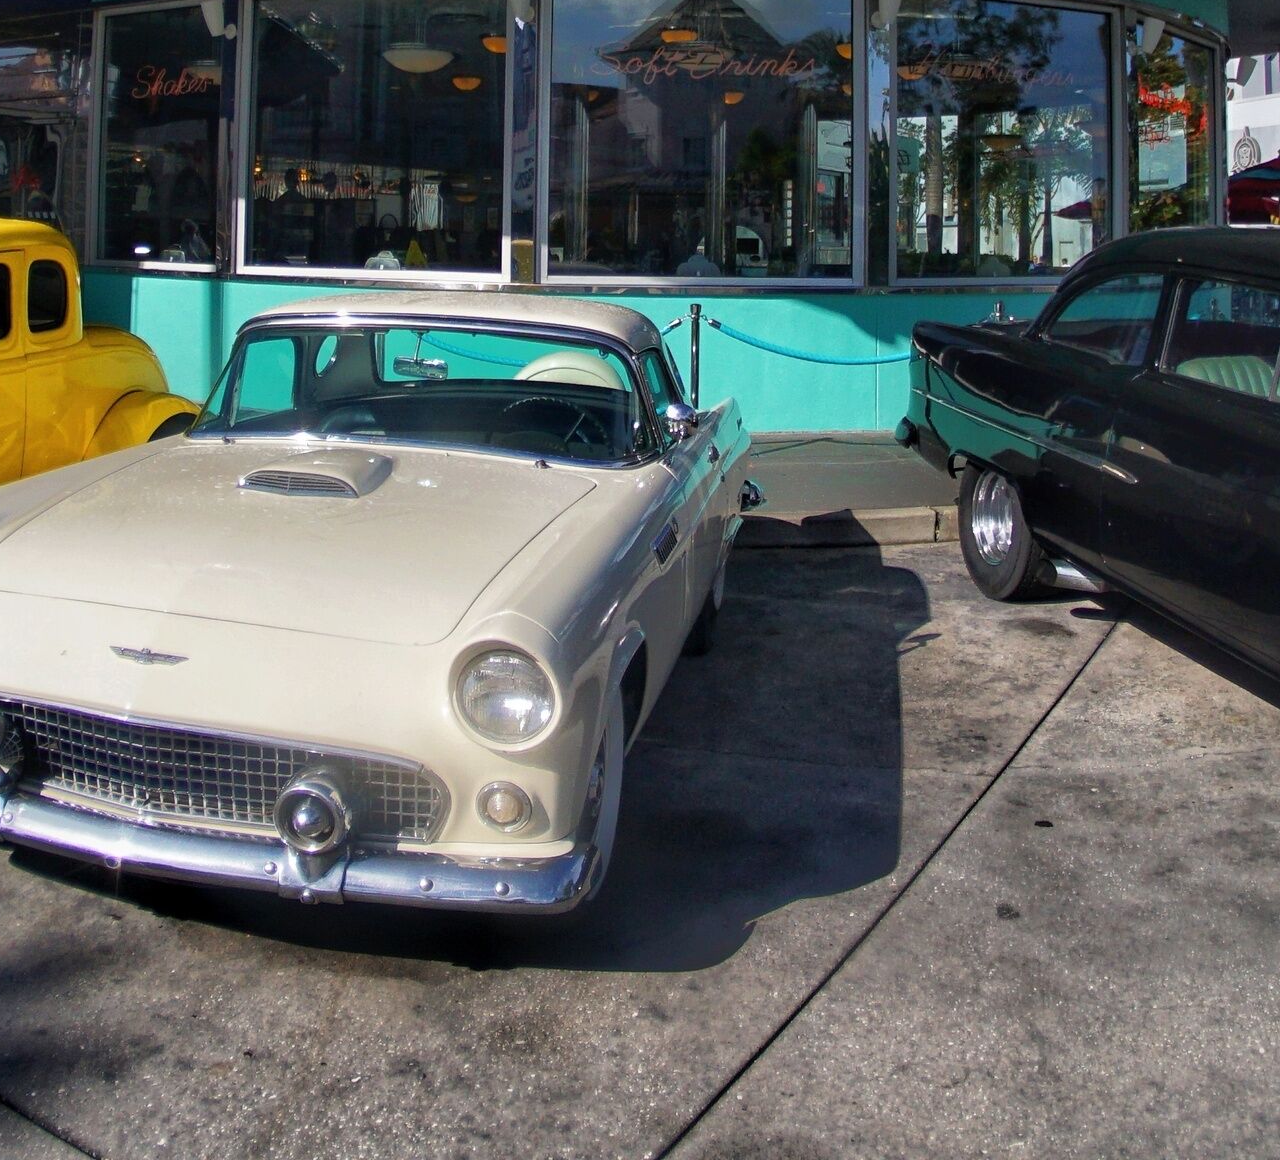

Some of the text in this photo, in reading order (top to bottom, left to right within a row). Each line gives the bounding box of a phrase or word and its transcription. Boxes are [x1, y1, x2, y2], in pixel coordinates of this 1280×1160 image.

[591, 43, 678, 85] Soft
[686, 45, 816, 80] Drinks
[131, 65, 208, 99] Shakes
